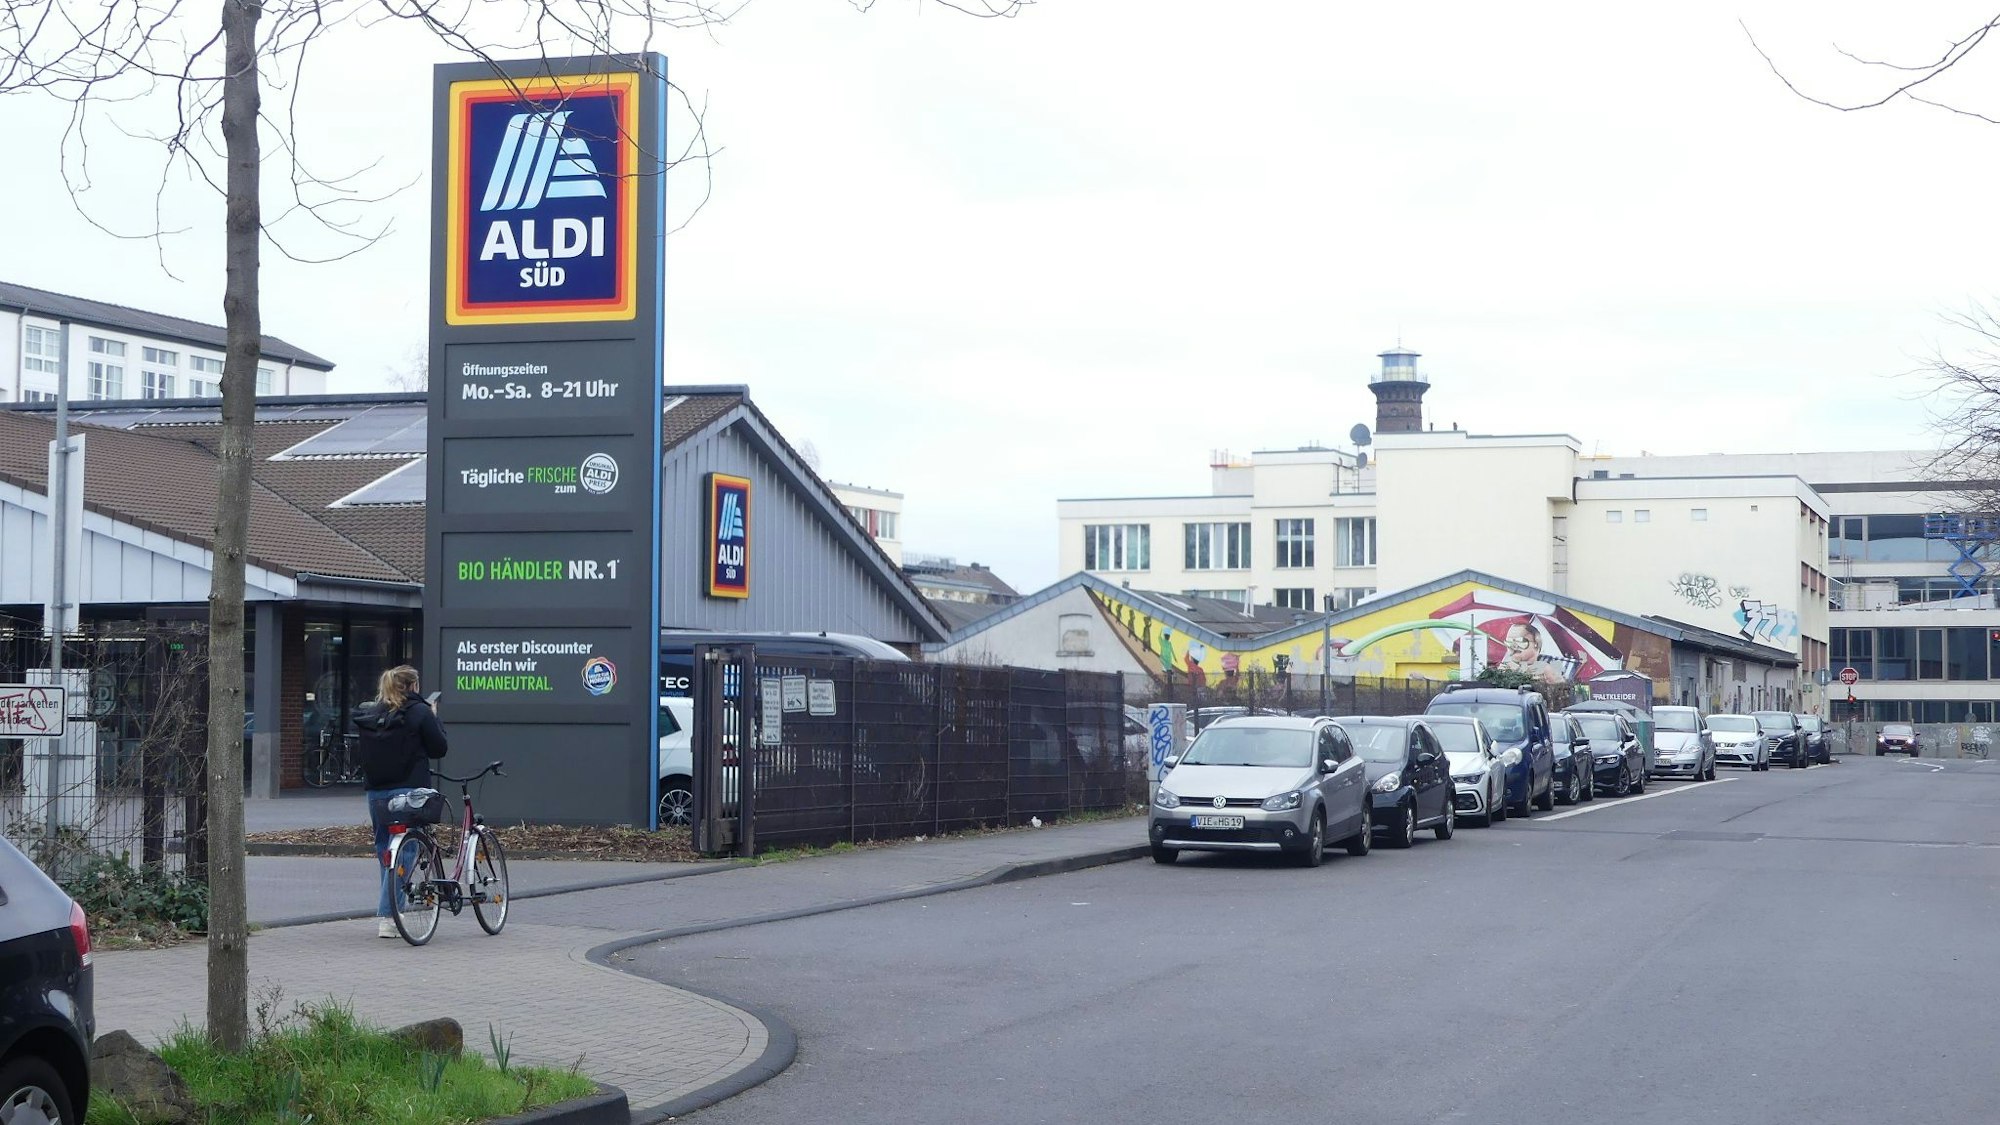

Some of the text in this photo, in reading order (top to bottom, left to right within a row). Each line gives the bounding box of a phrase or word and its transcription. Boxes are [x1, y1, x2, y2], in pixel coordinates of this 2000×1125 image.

[480, 216, 604, 261] ALDI
[520, 262, 566, 288] SÜD
[462, 363, 548, 378] Öffnungszeiten
[585, 379, 619, 398] Uhr
[461, 467, 612, 488] Tägliche FRISCHE ALDI
[554, 485, 577, 494] zum
[718, 544, 744, 566] ALDI
[458, 561, 485, 580] BIO
[490, 557, 563, 580] HÄNDLER
[726, 566, 737, 579] SÜD
[457, 640, 593, 654] Als erster Discounter
[457, 658, 537, 672] handeln wir
[457, 676, 553, 691] KLIMANEUTRAL.
[1841, 673, 1857, 681] STOP
[1197, 817, 1213, 826] VIE
[1231, 818, 1242, 827] 19
